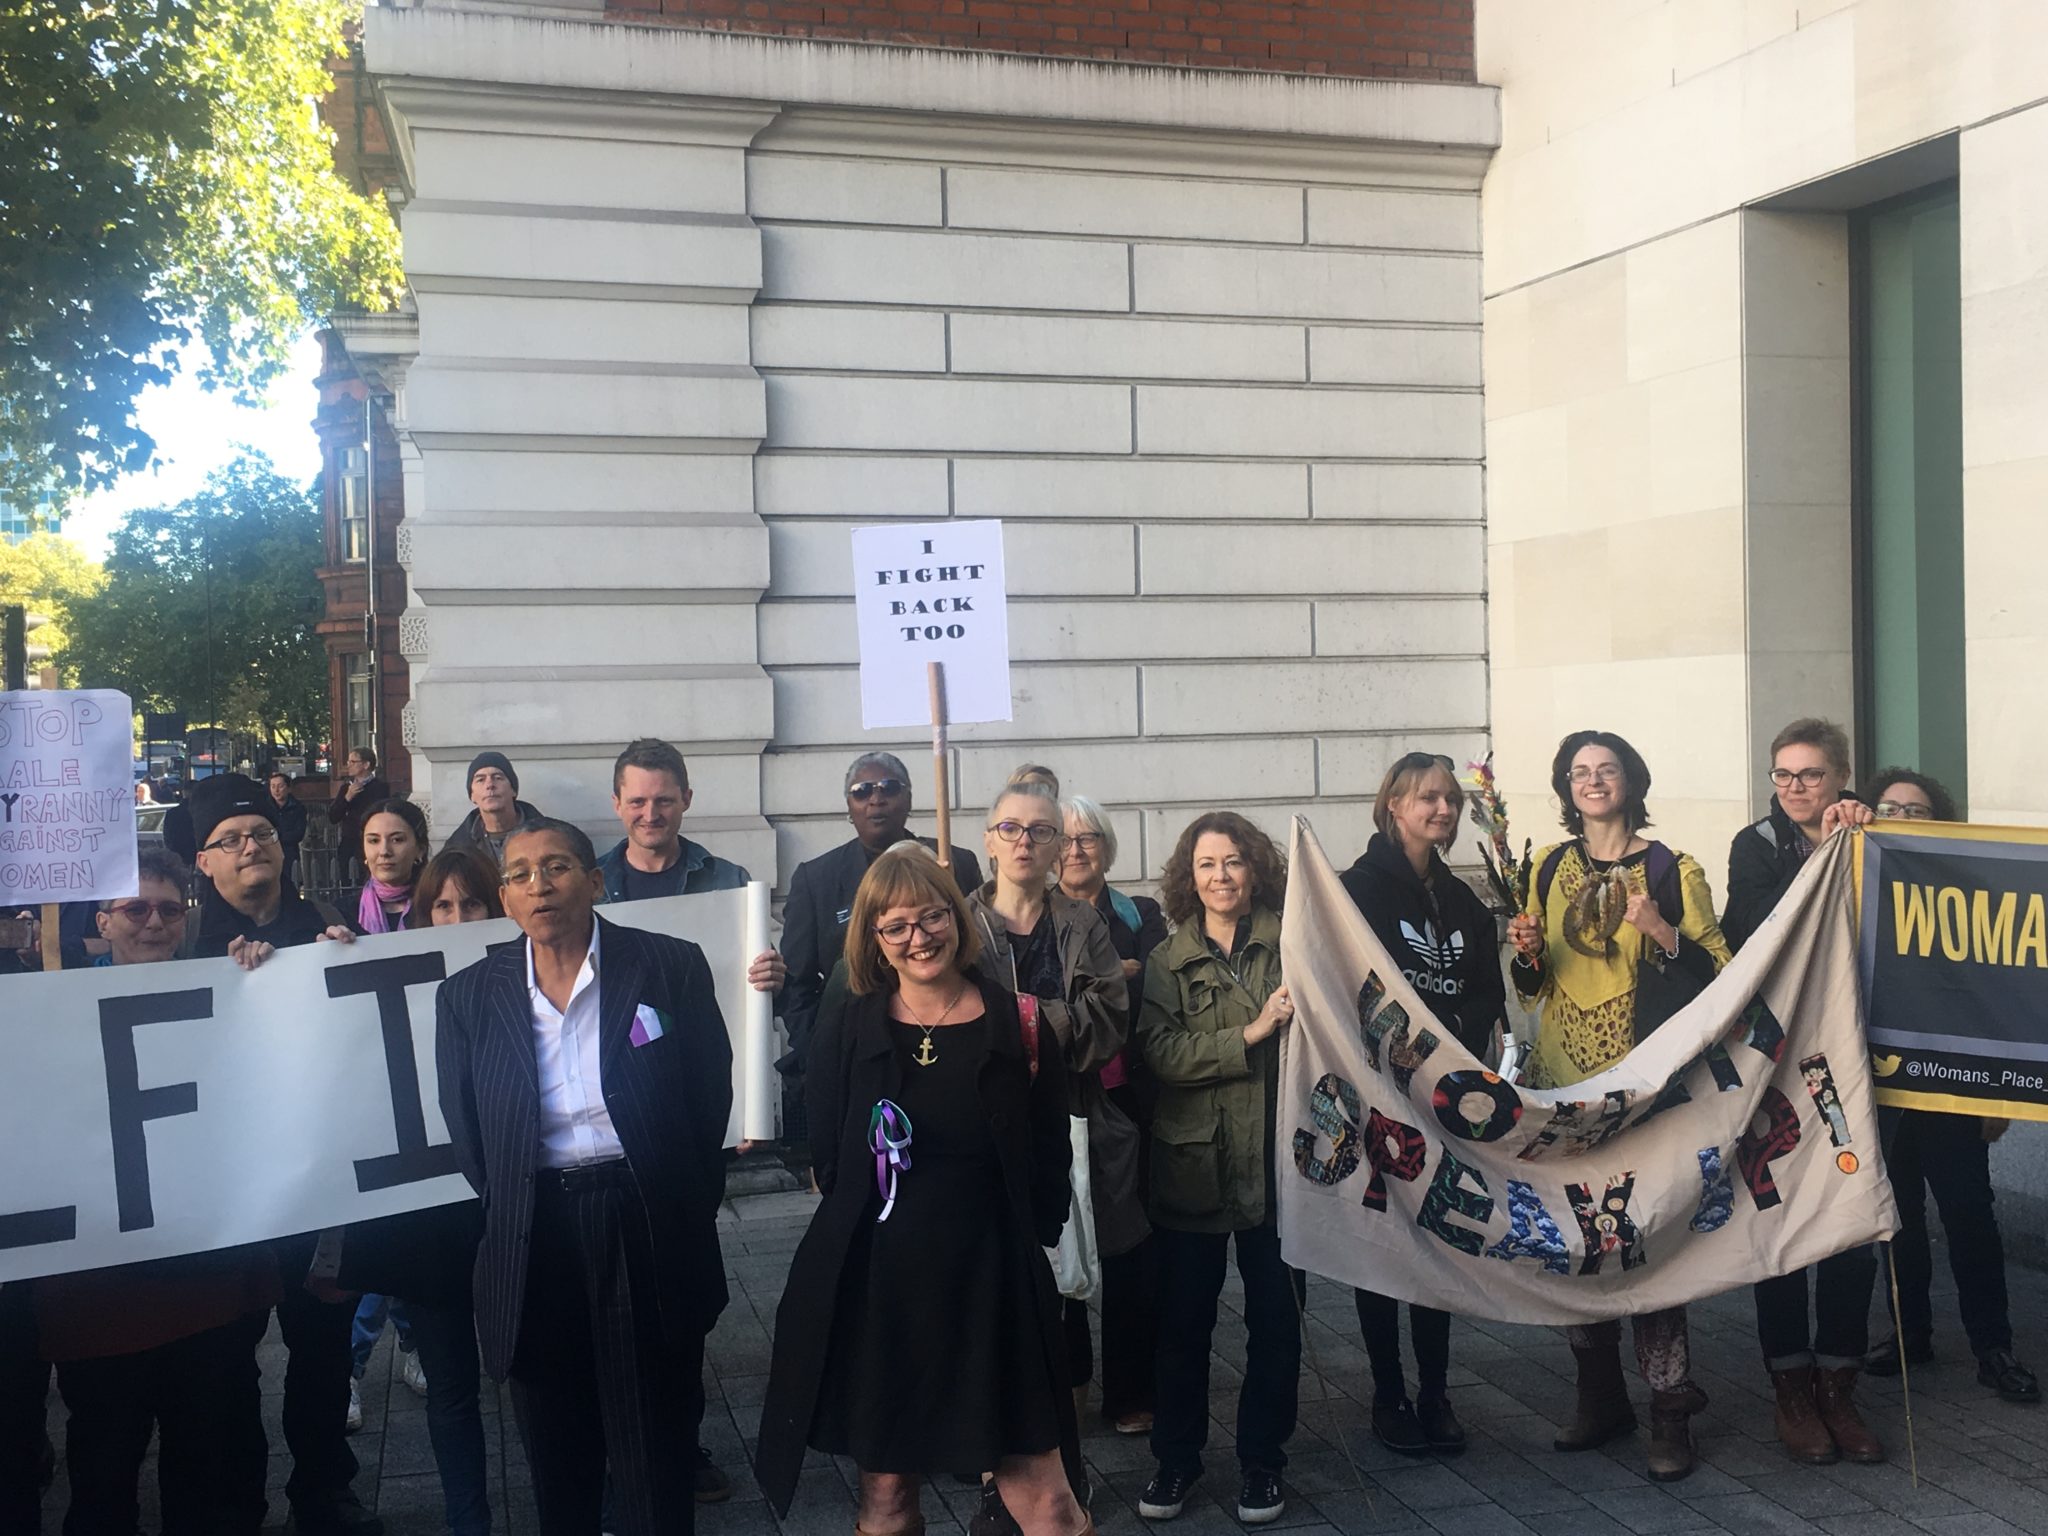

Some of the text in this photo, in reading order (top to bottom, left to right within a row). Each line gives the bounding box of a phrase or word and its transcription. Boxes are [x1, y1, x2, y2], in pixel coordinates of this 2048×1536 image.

[920, 539, 935, 555] I
[874, 564, 985, 586] FIGHT
[888, 596, 975, 616] BACK
[900, 624, 965, 642] TOO
[0, 758, 81, 789] ALE
[1892, 881, 2048, 968] WOMA
[1403, 968, 1465, 996] adidas
[1292, 1072, 1647, 1277] SPEAK
